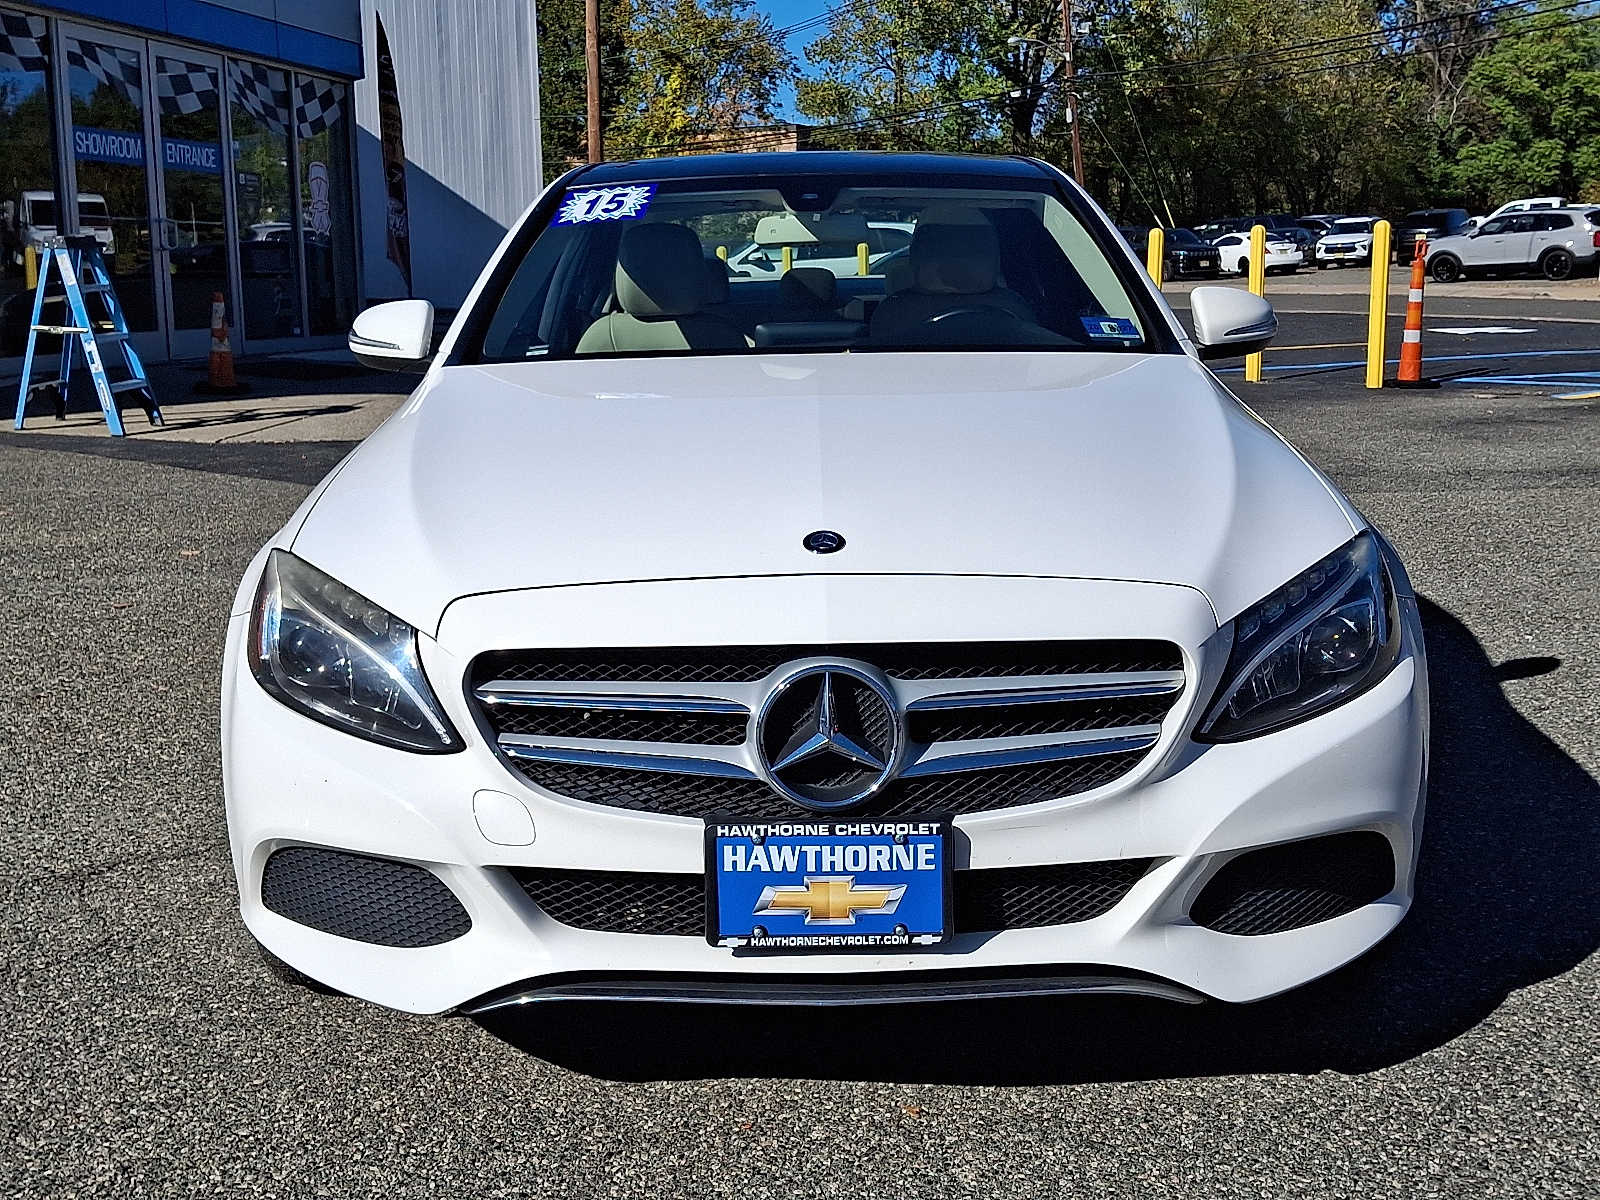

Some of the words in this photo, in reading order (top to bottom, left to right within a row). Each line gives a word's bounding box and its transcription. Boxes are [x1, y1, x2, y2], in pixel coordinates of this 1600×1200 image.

[75, 131, 142, 159] SHOWROOM
[166, 142, 217, 168] ENTRANCE
[583, 192, 630, 215] 15
[717, 824, 830, 837] HAWTHORNE
[835, 823, 941, 836] CHEVROLET
[723, 843, 936, 873] HAWTHORNE
[750, 935, 909, 947] HAWTHORNECHEVROLET.COM
